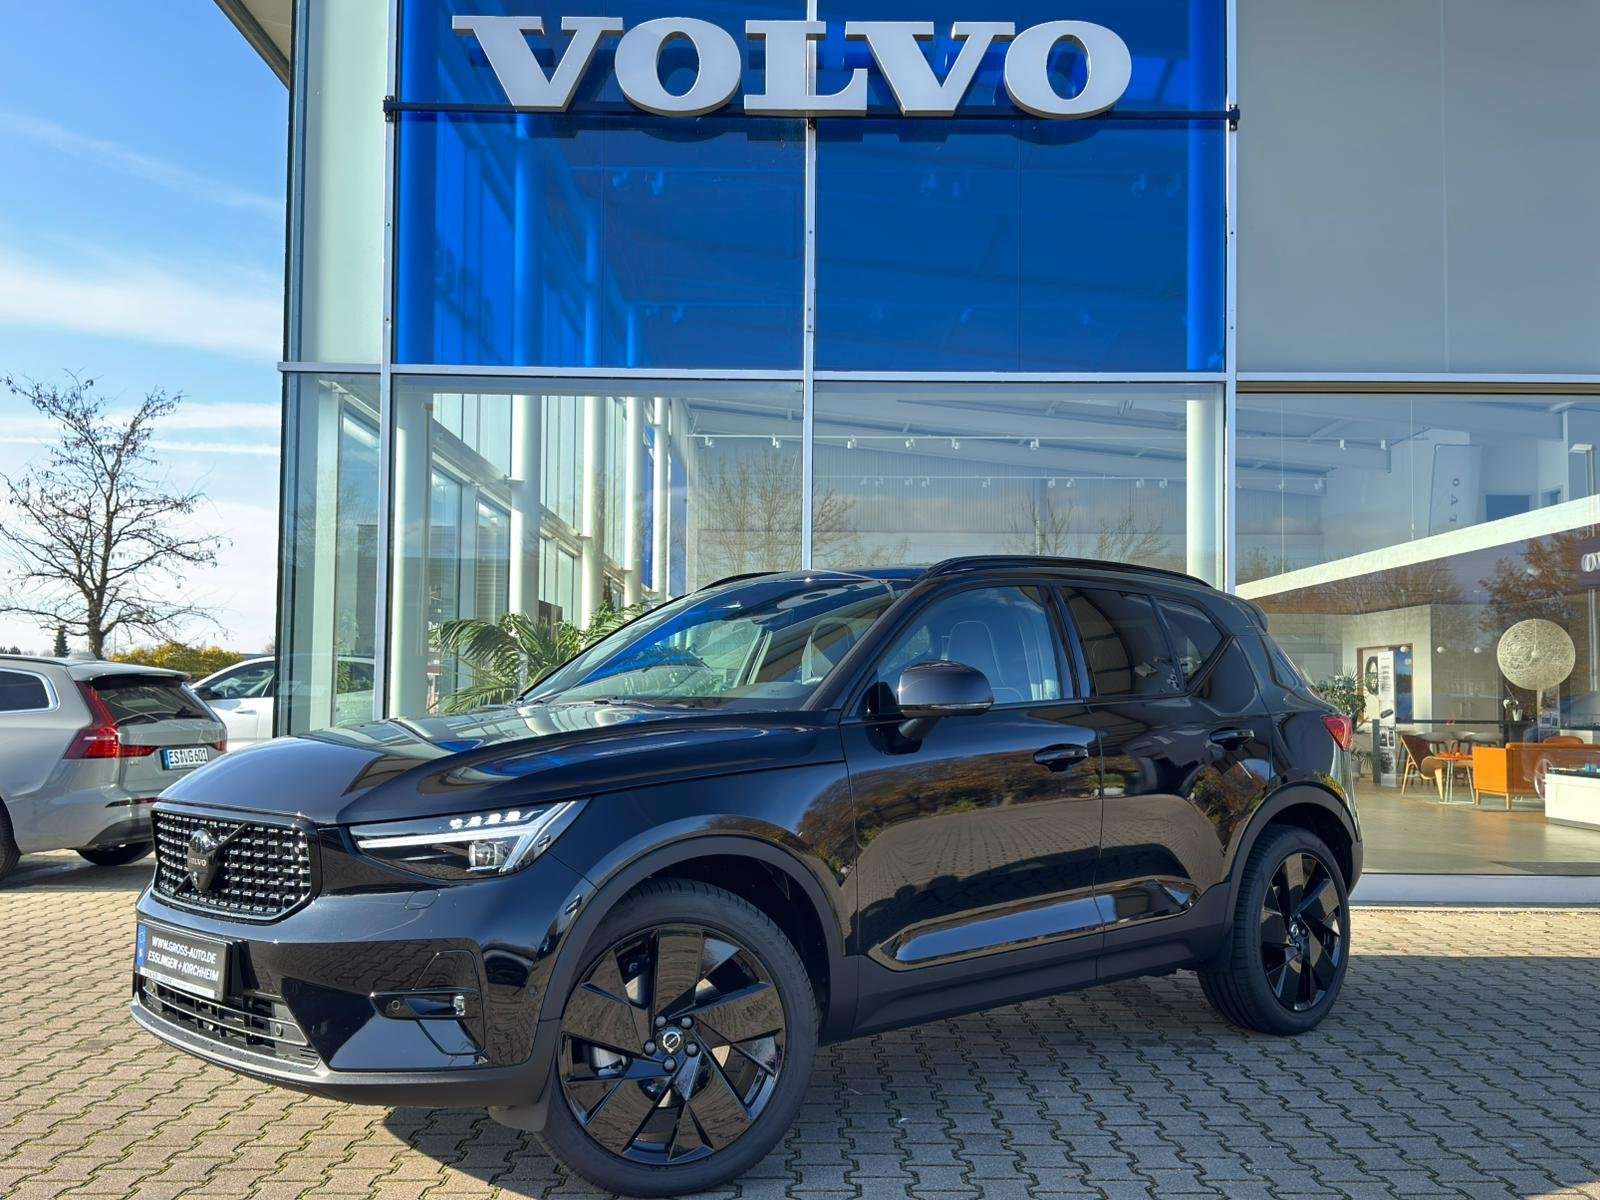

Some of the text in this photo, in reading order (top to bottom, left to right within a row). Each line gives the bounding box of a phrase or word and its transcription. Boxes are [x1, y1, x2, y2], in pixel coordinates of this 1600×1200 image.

[452, 16, 1132, 118] VOLVO
[147, 949, 177, 970] ESSLINGEN
[182, 961, 219, 981] KIRCHHEIM
[151, 935, 217, 965] WWW.GROSS-AUTO.DE
